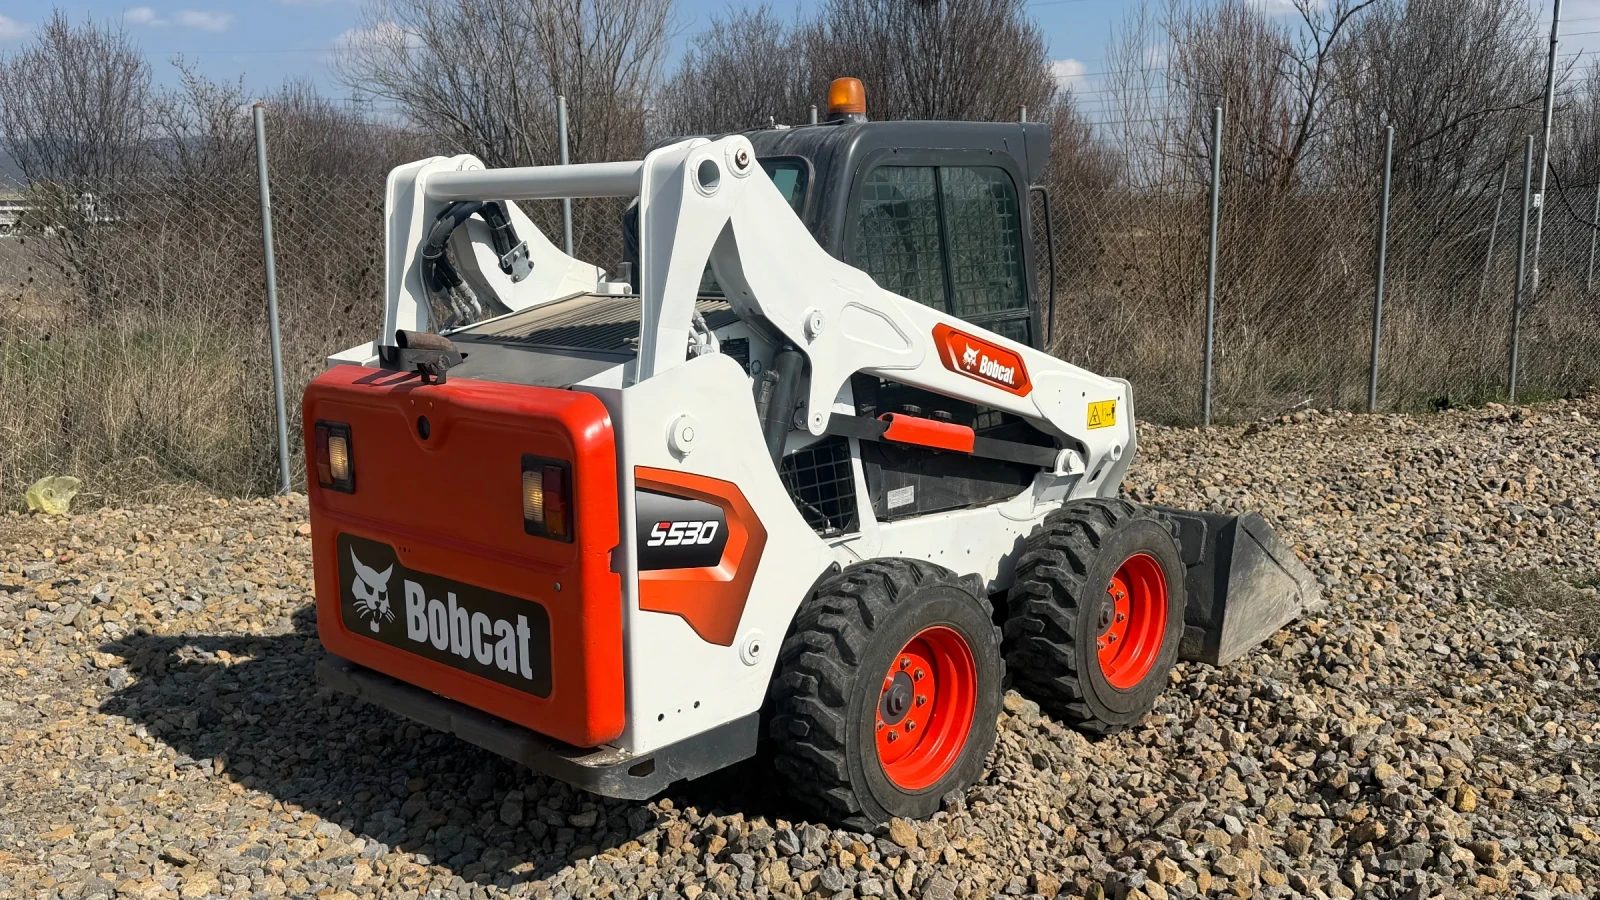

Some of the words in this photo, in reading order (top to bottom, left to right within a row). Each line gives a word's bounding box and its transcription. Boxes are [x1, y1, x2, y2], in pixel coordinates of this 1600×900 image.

[979, 355, 1014, 385] Bobcat
[647, 521, 719, 546] S530
[404, 579, 533, 680] Bobcat
